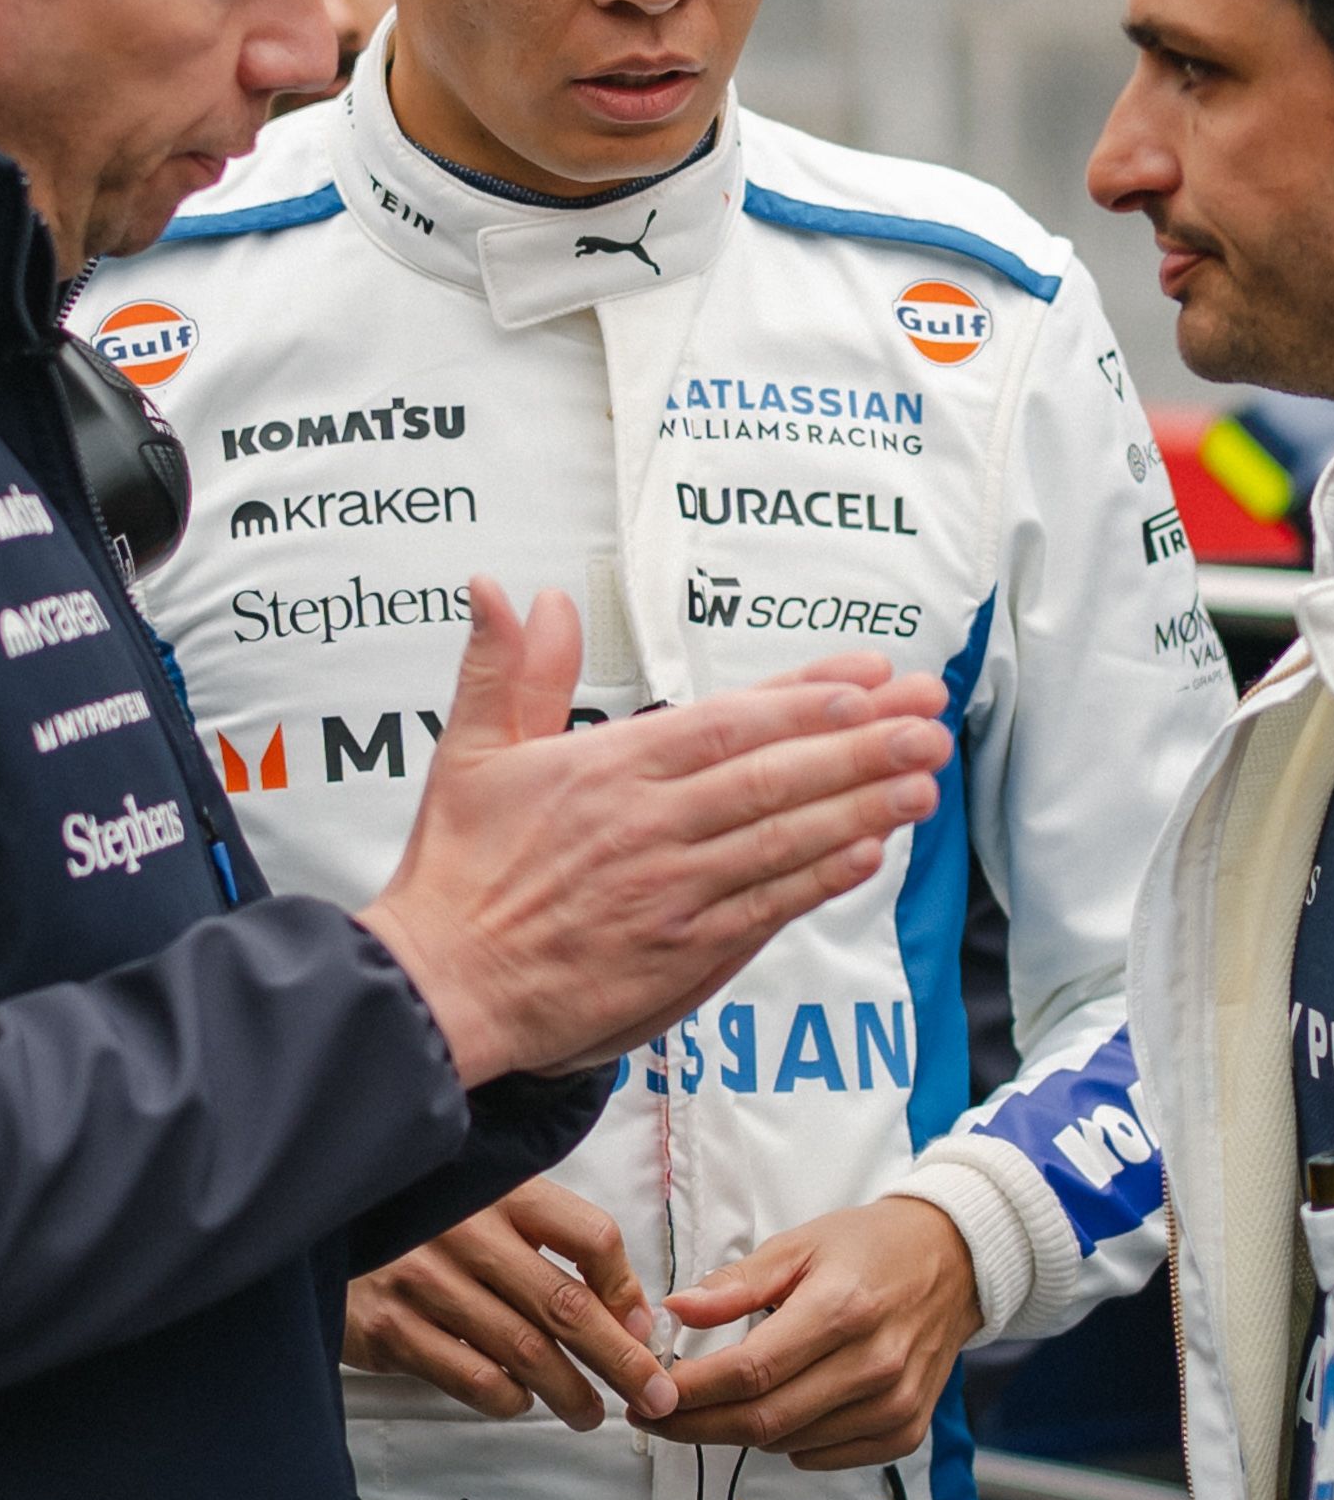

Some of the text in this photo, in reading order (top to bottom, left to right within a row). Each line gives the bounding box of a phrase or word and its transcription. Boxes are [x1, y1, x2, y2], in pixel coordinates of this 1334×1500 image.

[95, 323, 193, 362] Gulf
[896, 305, 988, 340] Gulf
[686, 378, 924, 425] ATLASSIAN
[221, 397, 467, 461] KOMATSU
[807, 424, 924, 456] RACING
[676, 482, 918, 536] DURACELL
[231, 576, 476, 645] Stephens
[746, 596, 922, 638] SCORES
[62, 793, 186, 878] Stephens
